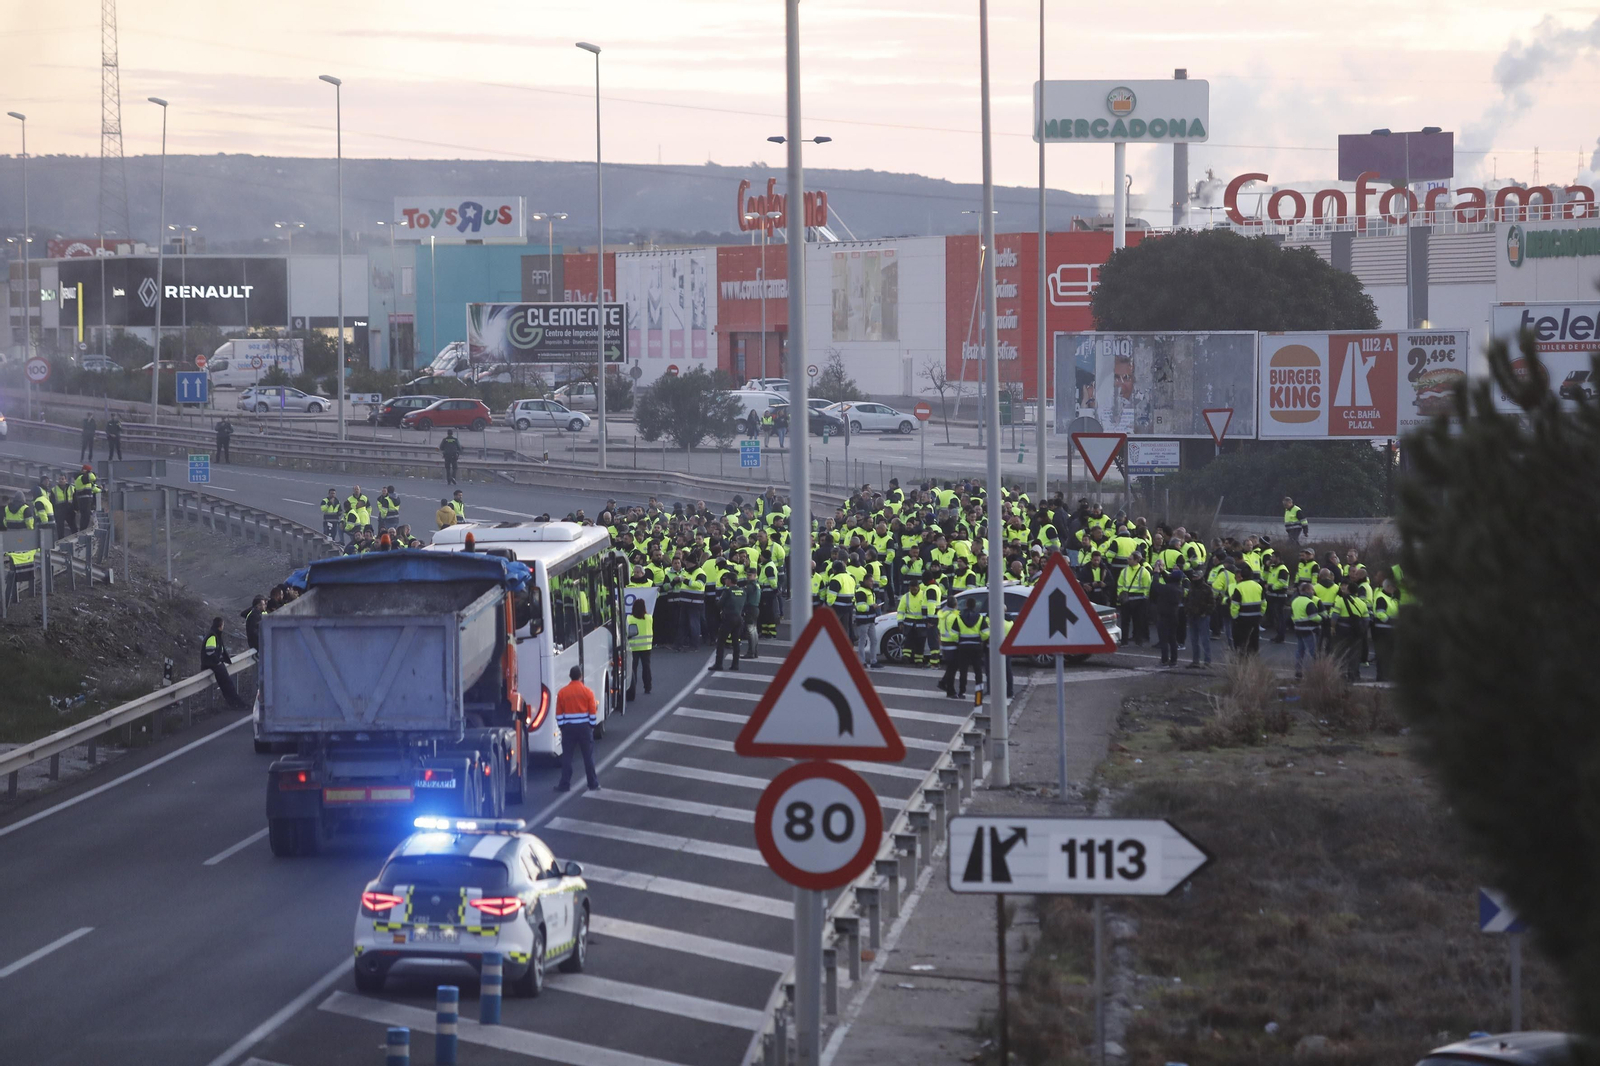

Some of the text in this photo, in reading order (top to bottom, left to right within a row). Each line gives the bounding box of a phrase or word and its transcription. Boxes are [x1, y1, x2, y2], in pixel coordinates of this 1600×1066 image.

[1037, 117, 1206, 139] MERCADONA
[1223, 170, 1595, 235] Conforama
[165, 286, 253, 298] RENAULT
[527, 308, 620, 326] CLEMENTE
[546, 329, 564, 337] Centro
[564, 329, 572, 337] de
[604, 329, 620, 338] igital
[1407, 335, 1456, 346] WHOPPER
[1362, 338, 1394, 353] 1112 A
[28, 366, 47, 375] 100
[1270, 369, 1322, 386] BURGER
[1270, 386, 1322, 409] KING
[1343, 408, 1381, 420] C.C. BAHÍA
[1348, 421, 1375, 430] PLAZA.
[784, 801, 855, 843] 80
[1060, 838, 1147, 881] 1113
